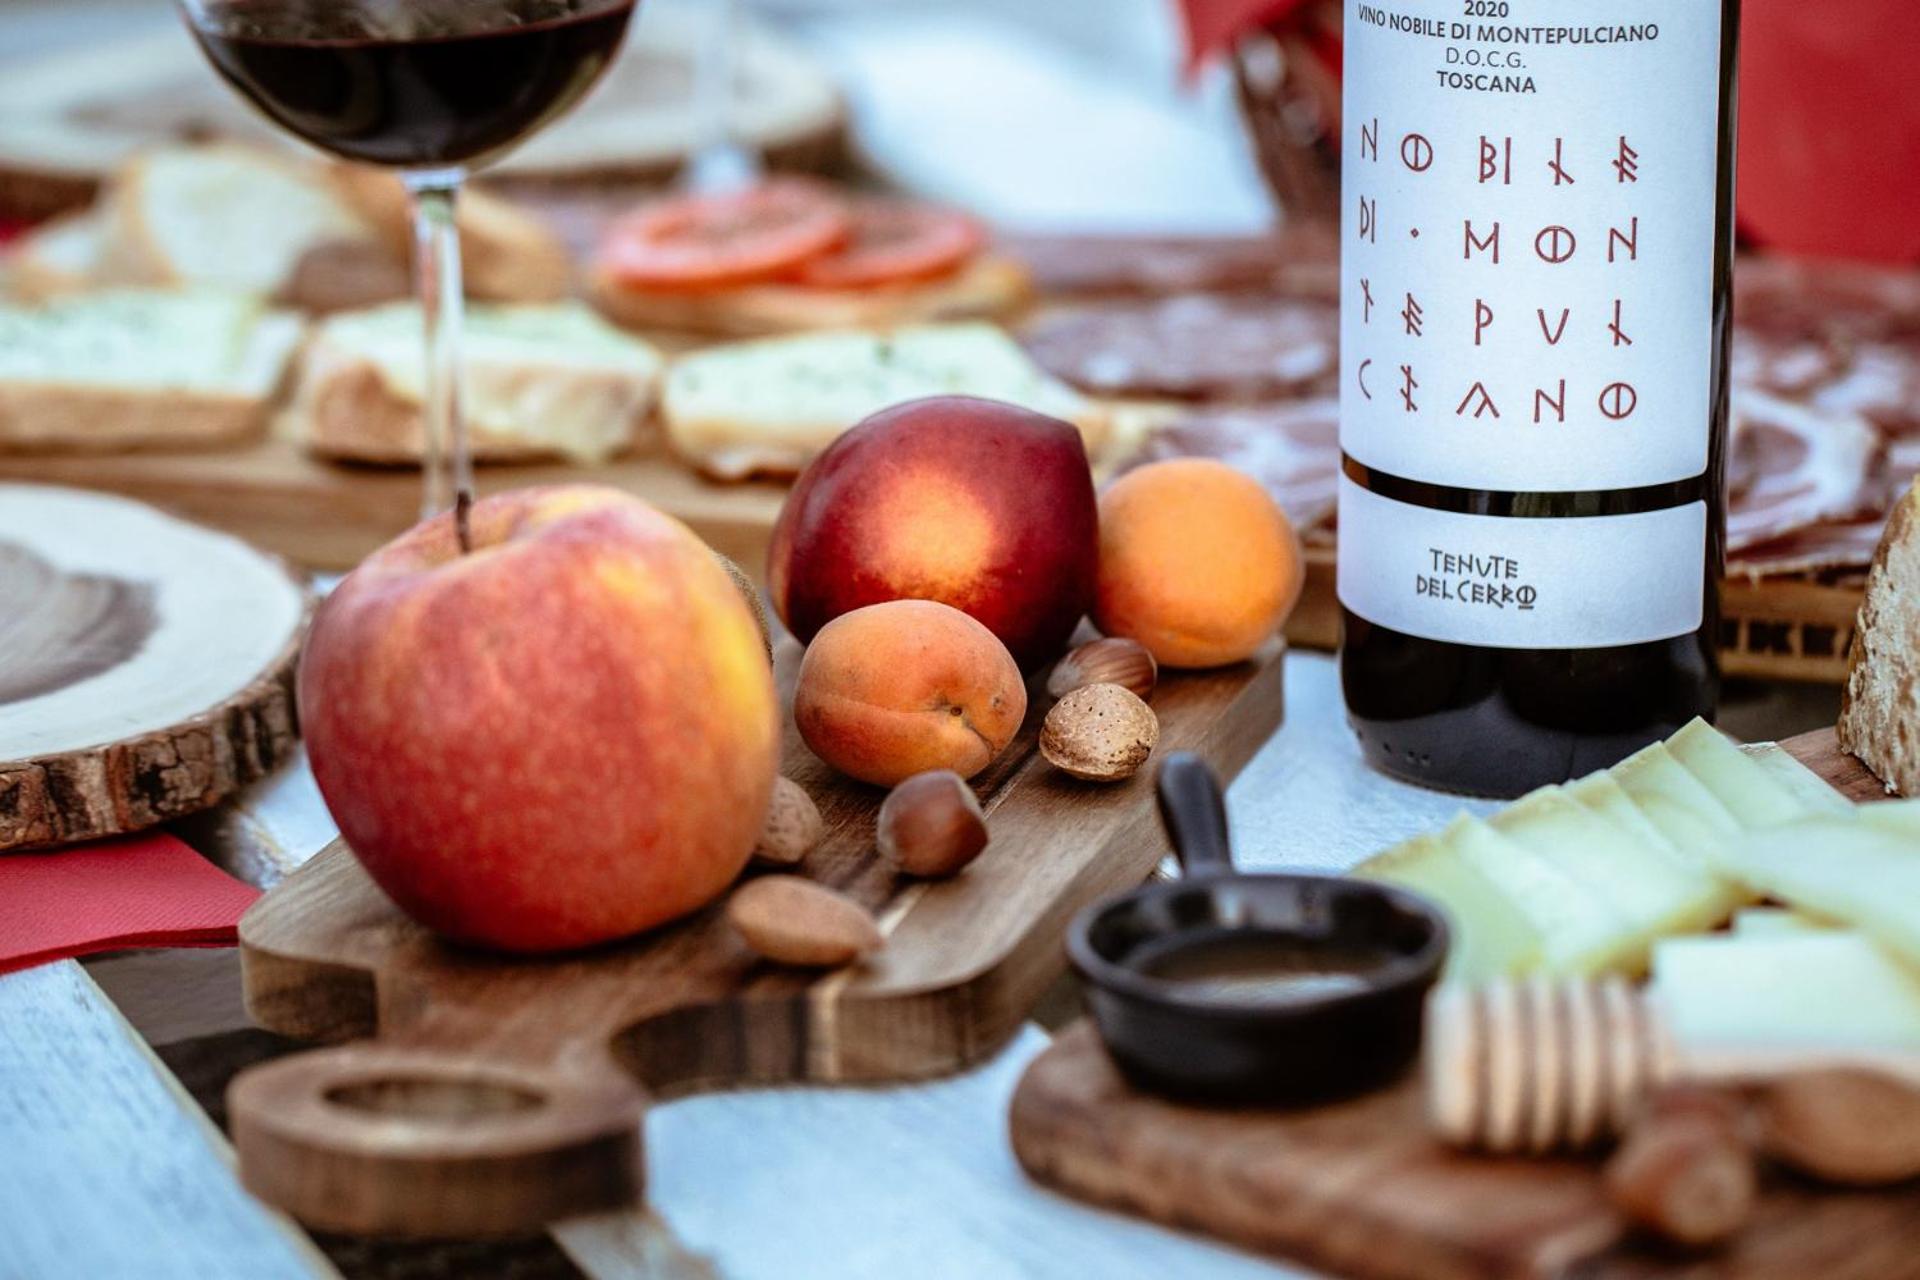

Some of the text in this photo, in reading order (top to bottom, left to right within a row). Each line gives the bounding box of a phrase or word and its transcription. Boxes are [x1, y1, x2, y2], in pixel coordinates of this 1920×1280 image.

[1464, 0, 1509, 18] 2020
[1358, 3, 1659, 44] VINO NOBILE DI MONTEPULCIANO
[1445, 47, 1527, 69] D.O.C.G.
[1436, 70, 1537, 94] TOSCANA
[1429, 548, 1519, 580] TENUTE
